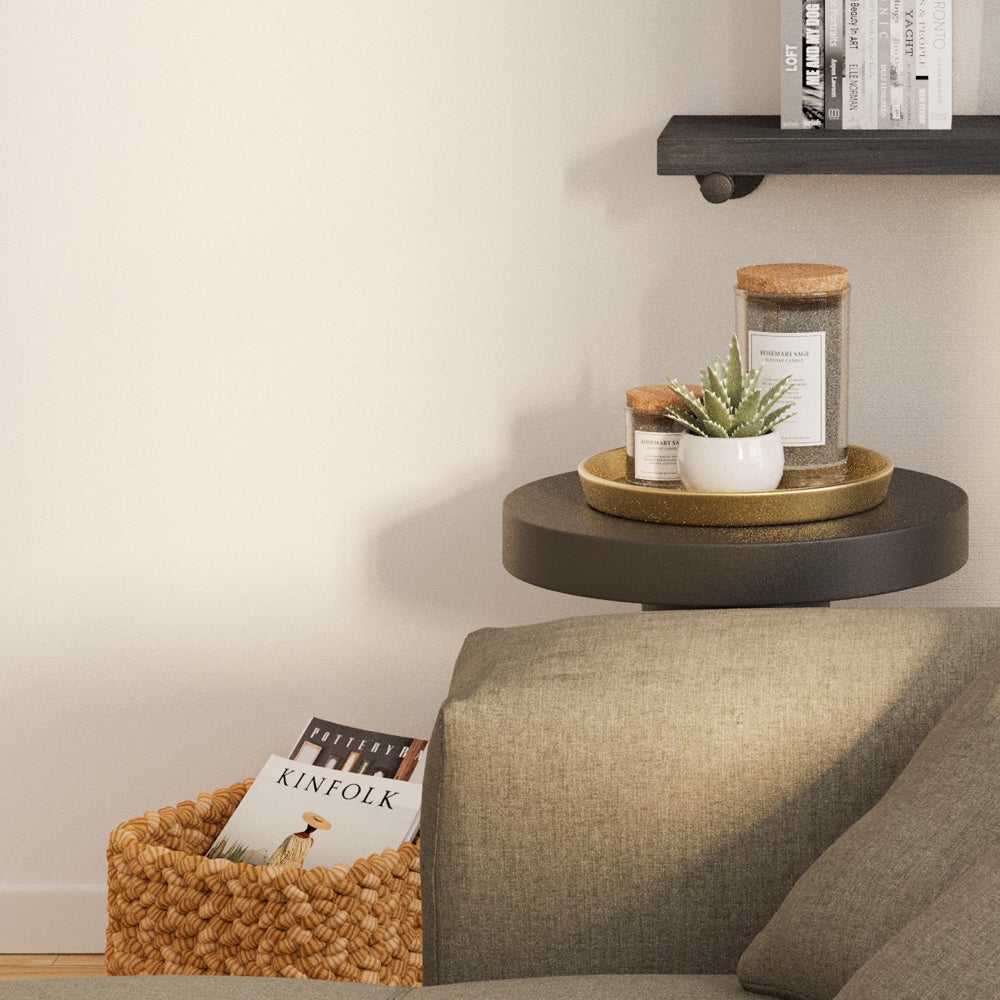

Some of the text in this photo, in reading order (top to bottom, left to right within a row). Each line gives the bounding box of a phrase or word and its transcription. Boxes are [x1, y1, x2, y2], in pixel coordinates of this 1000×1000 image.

[829, 9, 838, 47] Portraits
[849, 2, 859, 26] Beauty
[905, 9, 914, 57] YACHT
[785, 44, 798, 72] LOFT
[806, 3, 820, 86] ME AND MY DOG
[849, 36, 858, 50] ART
[918, 21, 926, 69] PEOPLE
[849, 64, 858, 111] ELLE NORMAN
[310, 727, 396, 756] POTTERY
[276, 767, 400, 810] KINFOLK
